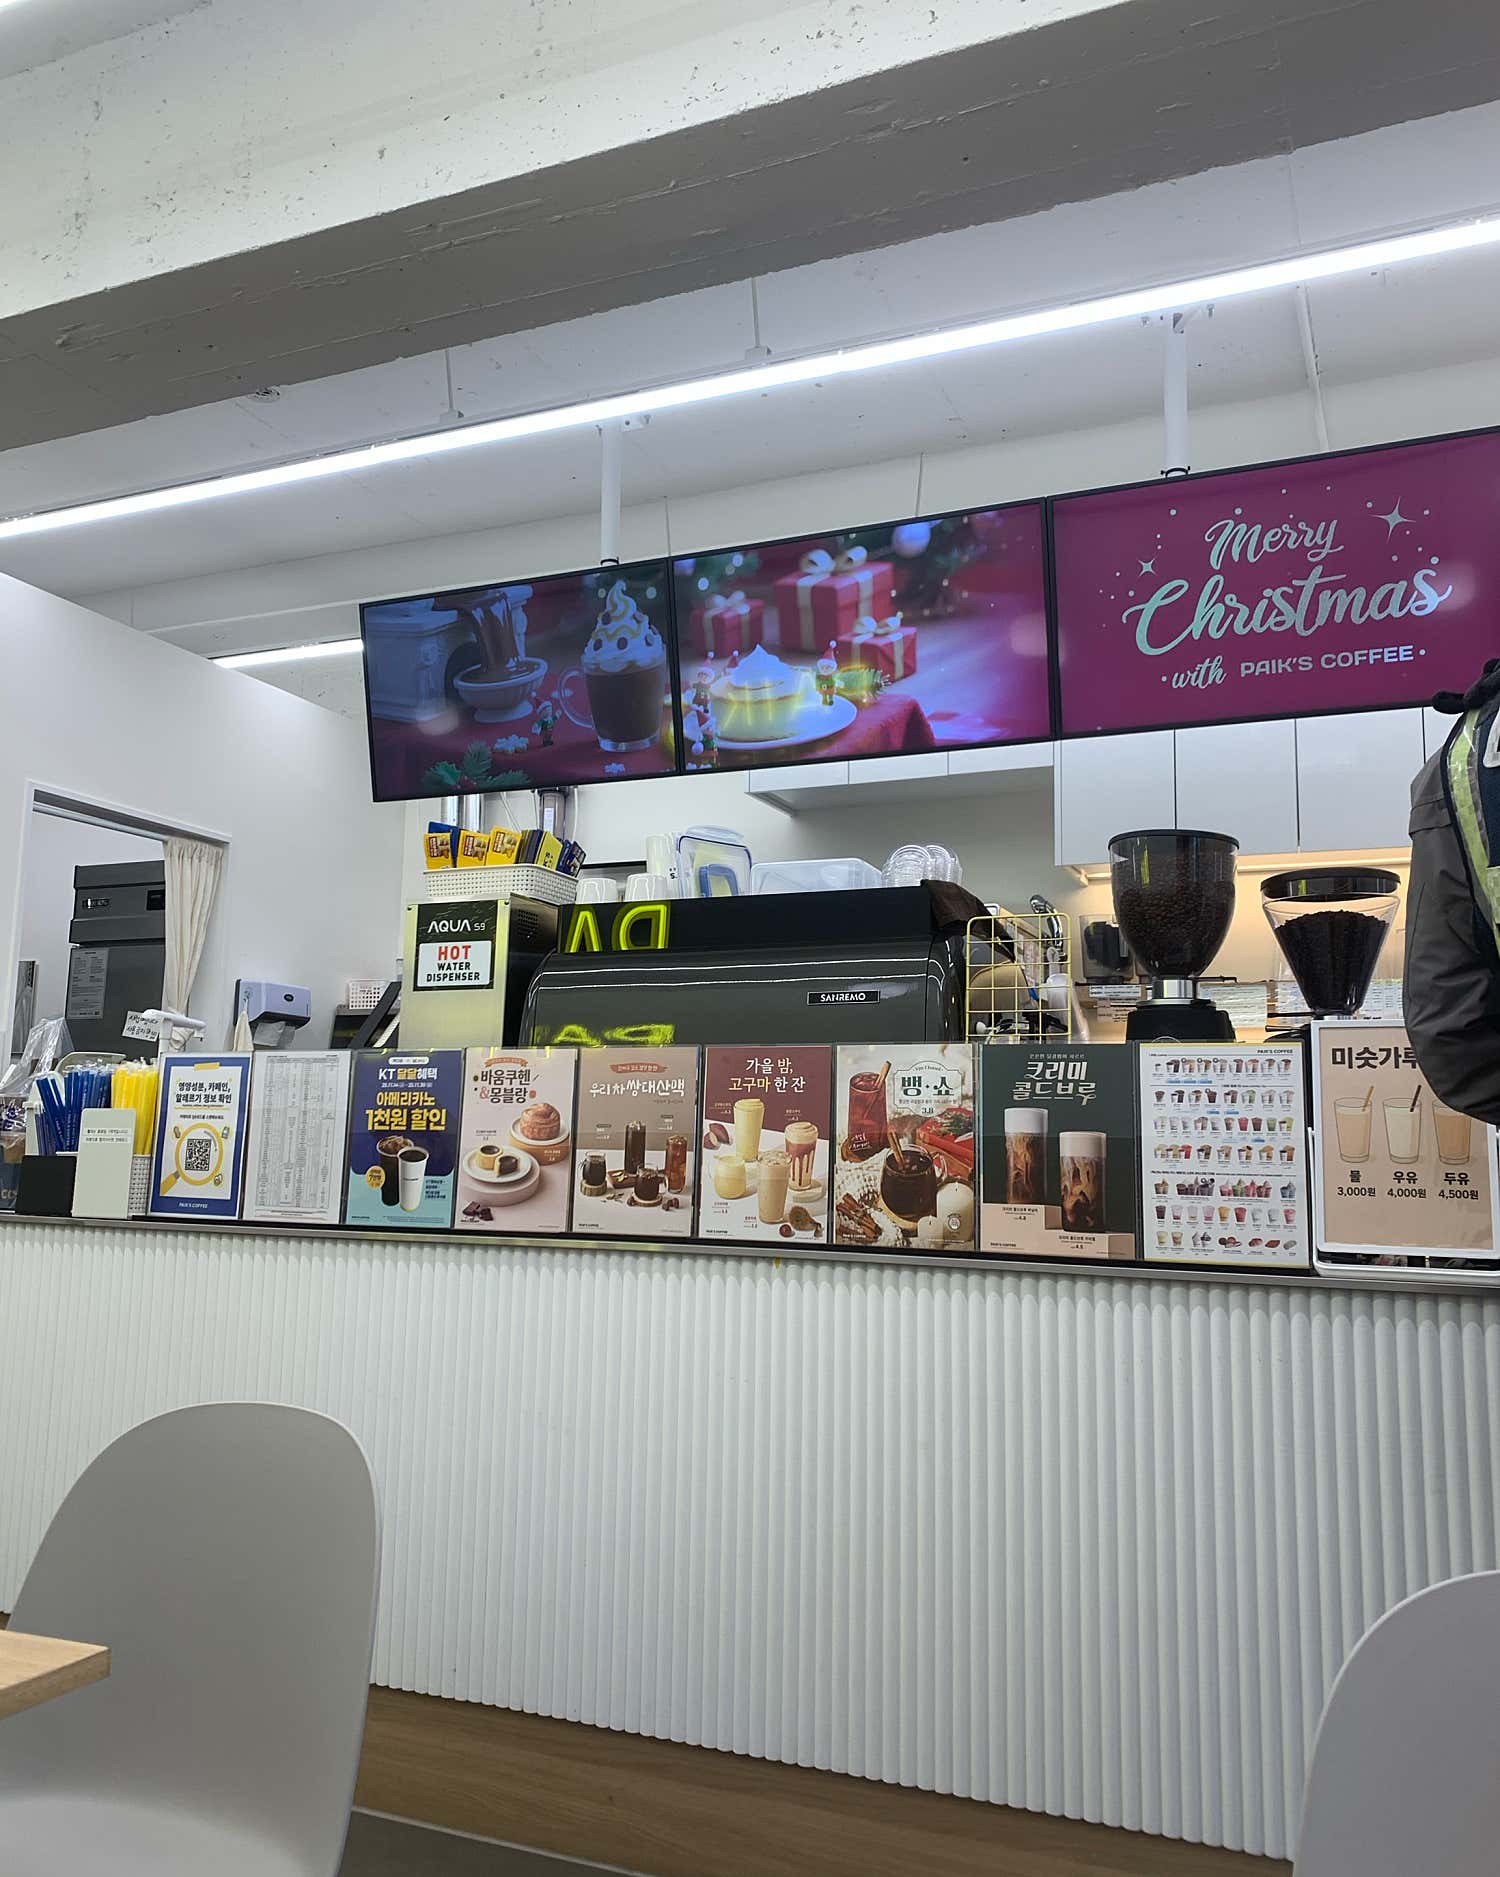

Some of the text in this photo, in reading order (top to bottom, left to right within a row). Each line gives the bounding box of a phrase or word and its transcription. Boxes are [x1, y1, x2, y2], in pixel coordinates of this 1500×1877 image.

[1204, 518, 1344, 571] Merry
[1121, 565, 1453, 656] Christmas
[1171, 645, 1414, 689] with PAIK'S COFFEE
[427, 919, 471, 934] AQUA
[438, 944, 472, 961] HOT
[437, 961, 471, 971] WATER
[426, 972, 480, 982] DISPENSER
[820, 992, 866, 1002] SANREMO
[378, 1068, 396, 1080] KT
[745, 1057, 793, 1074] 가을 밤,
[1024, 1061, 1088, 1080] 크리미
[480, 1069, 531, 1086] 바움쿠헨
[728, 1076, 806, 1093] 고구마 한 잔
[175, 1093, 232, 1104] 알레르기 정보 확인
[376, 1091, 436, 1106] 아메리카노
[1012, 1081, 1097, 1106] 콜드브루
[365, 1108, 447, 1131] 1천원 할인
[1349, 1170, 1470, 1185] 물 우유 두유
[1337, 1186, 1479, 1200] 3,000원 4,000원 4,500원
